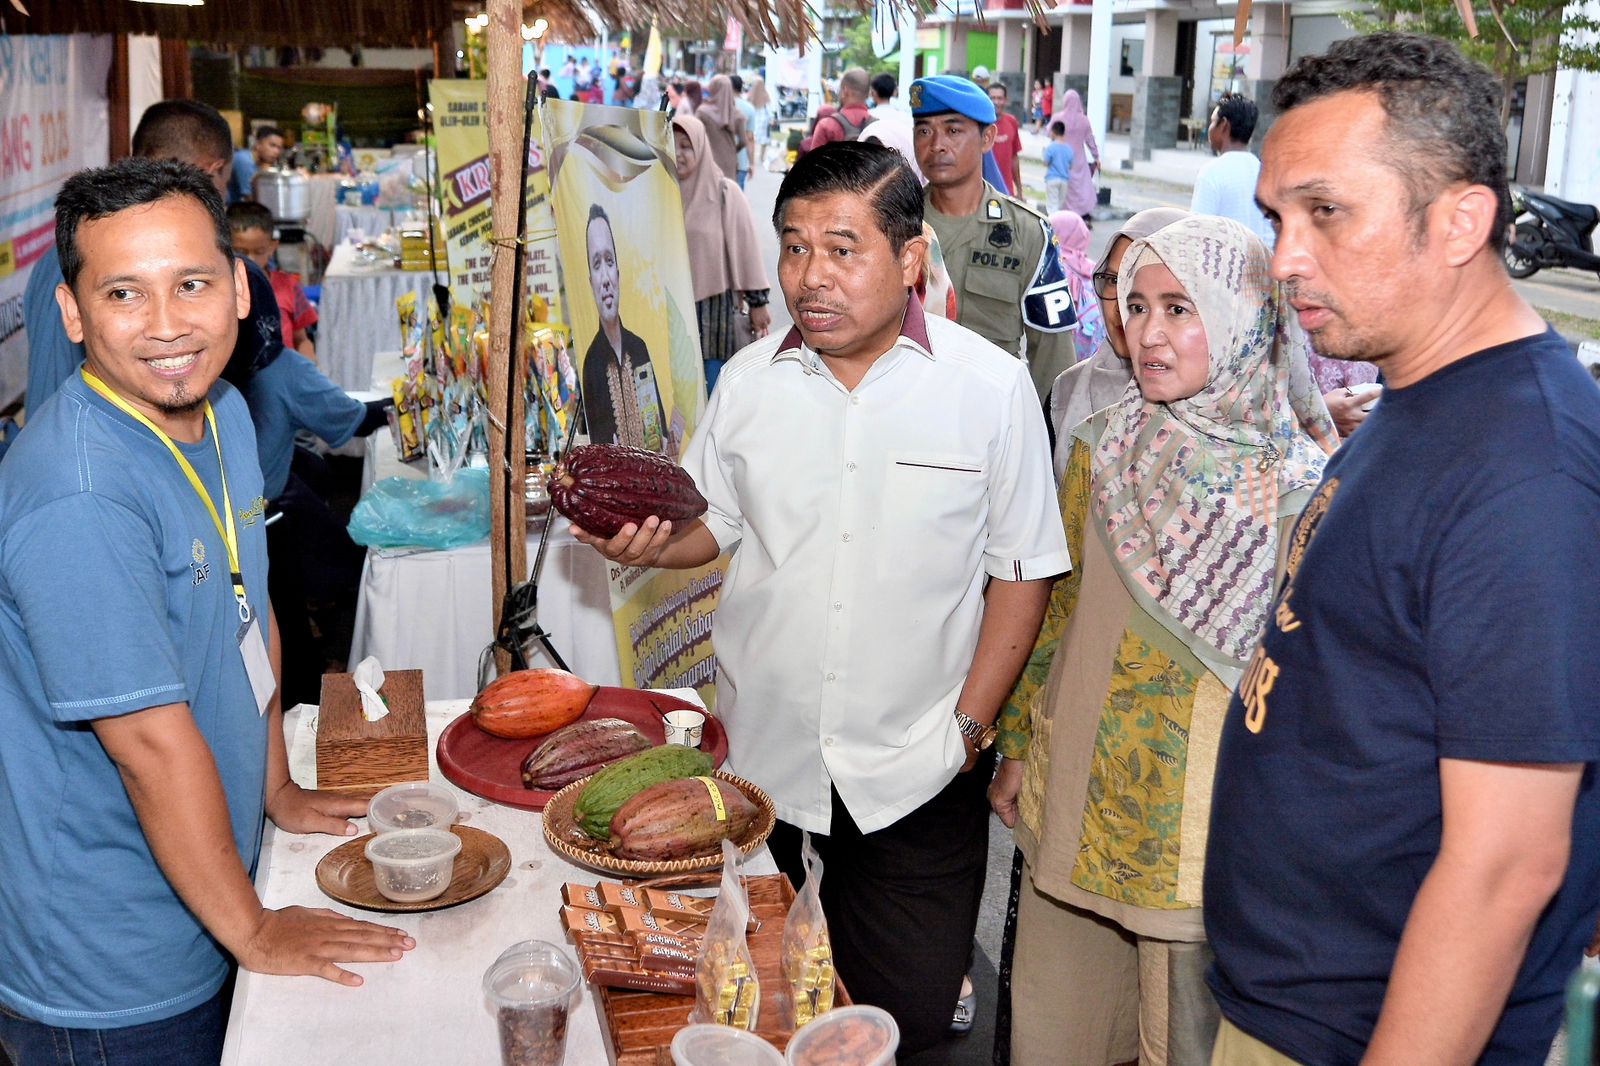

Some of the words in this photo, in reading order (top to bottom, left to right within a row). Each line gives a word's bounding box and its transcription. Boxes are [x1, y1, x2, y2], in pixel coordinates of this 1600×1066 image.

[972, 251, 999, 267] POL
[1003, 256, 1020, 270] PP
[1043, 290, 1070, 325] P
